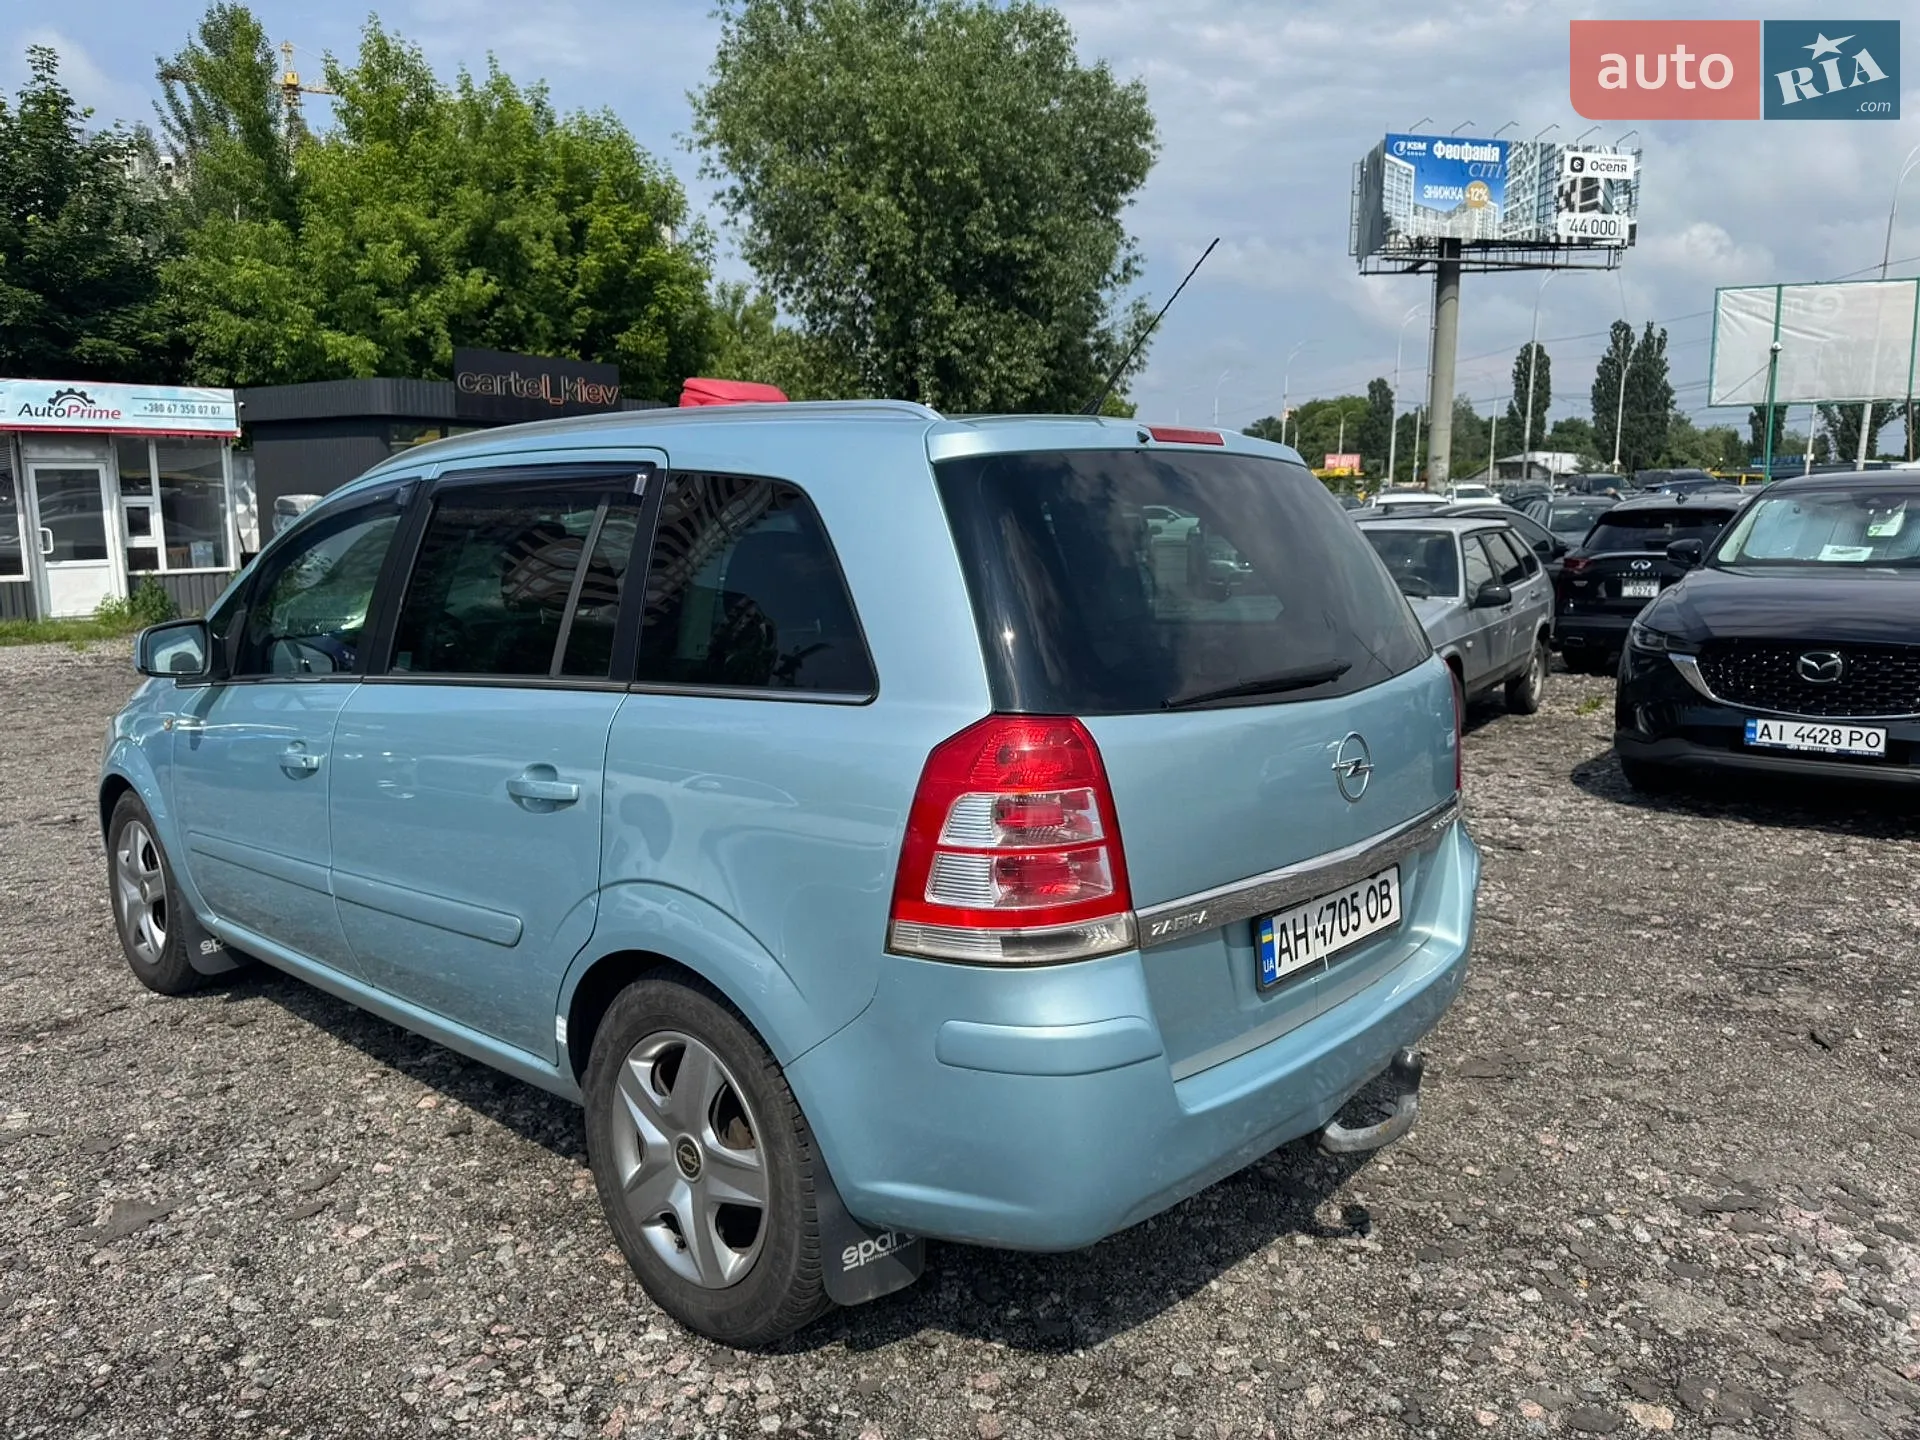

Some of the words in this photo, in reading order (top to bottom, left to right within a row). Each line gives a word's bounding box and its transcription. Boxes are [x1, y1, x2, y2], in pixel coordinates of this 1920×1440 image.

[1590, 160, 1627, 173] Оселя
[1423, 185, 1464, 200] ЗНИЖКА
[18, 402, 122, 420] AutoPrime
[1759, 723, 1784, 741] AI
[1794, 726, 1842, 746] 4428
[1849, 730, 1881, 748] PO
[1278, 913, 1310, 968] AH
[1315, 892, 1361, 947] 4705
[1366, 879, 1392, 923] OB
[1263, 957, 1275, 973] UA
